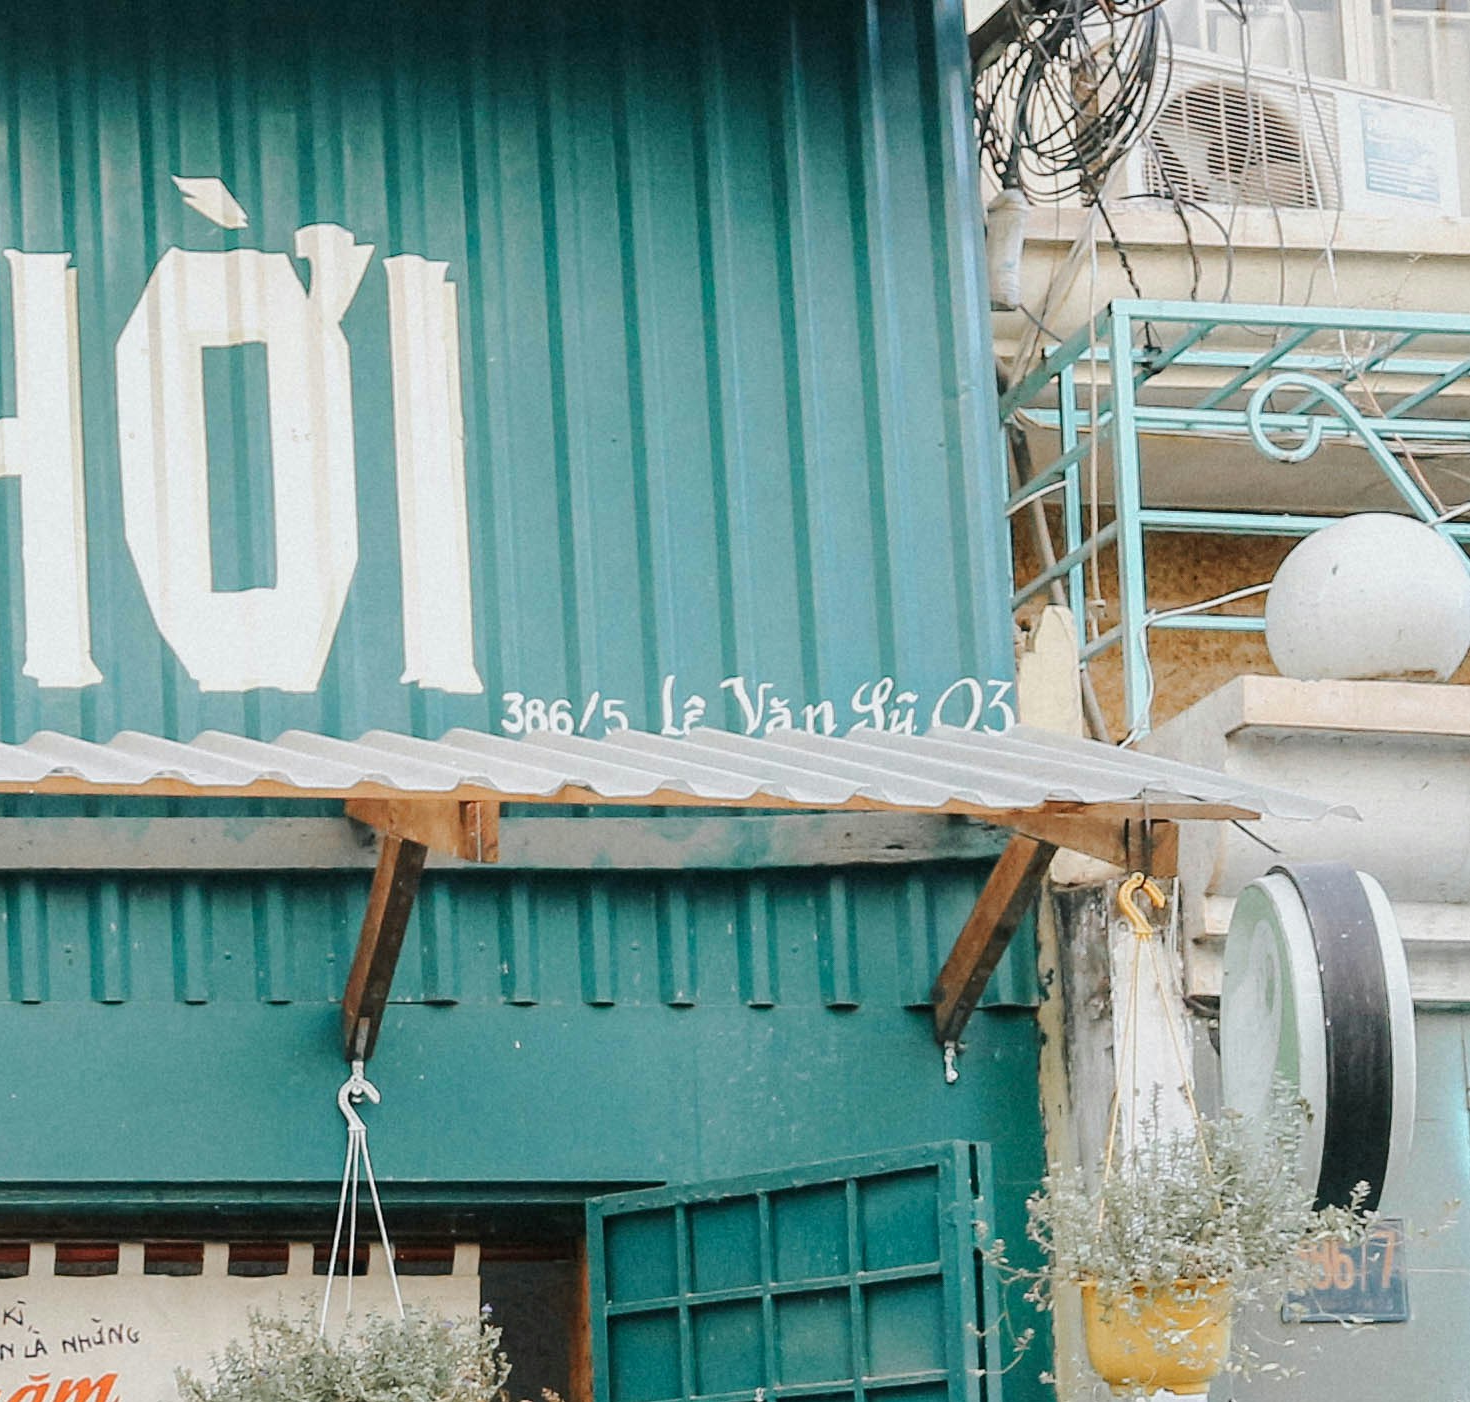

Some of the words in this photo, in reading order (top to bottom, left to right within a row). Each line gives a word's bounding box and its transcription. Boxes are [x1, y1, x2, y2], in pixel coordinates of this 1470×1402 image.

[501, 690, 629, 734] 386/5
[661, 674, 707, 736] Lê
[720, 676, 839, 736] Văn
[24, 1329, 49, 1359] LÀ
